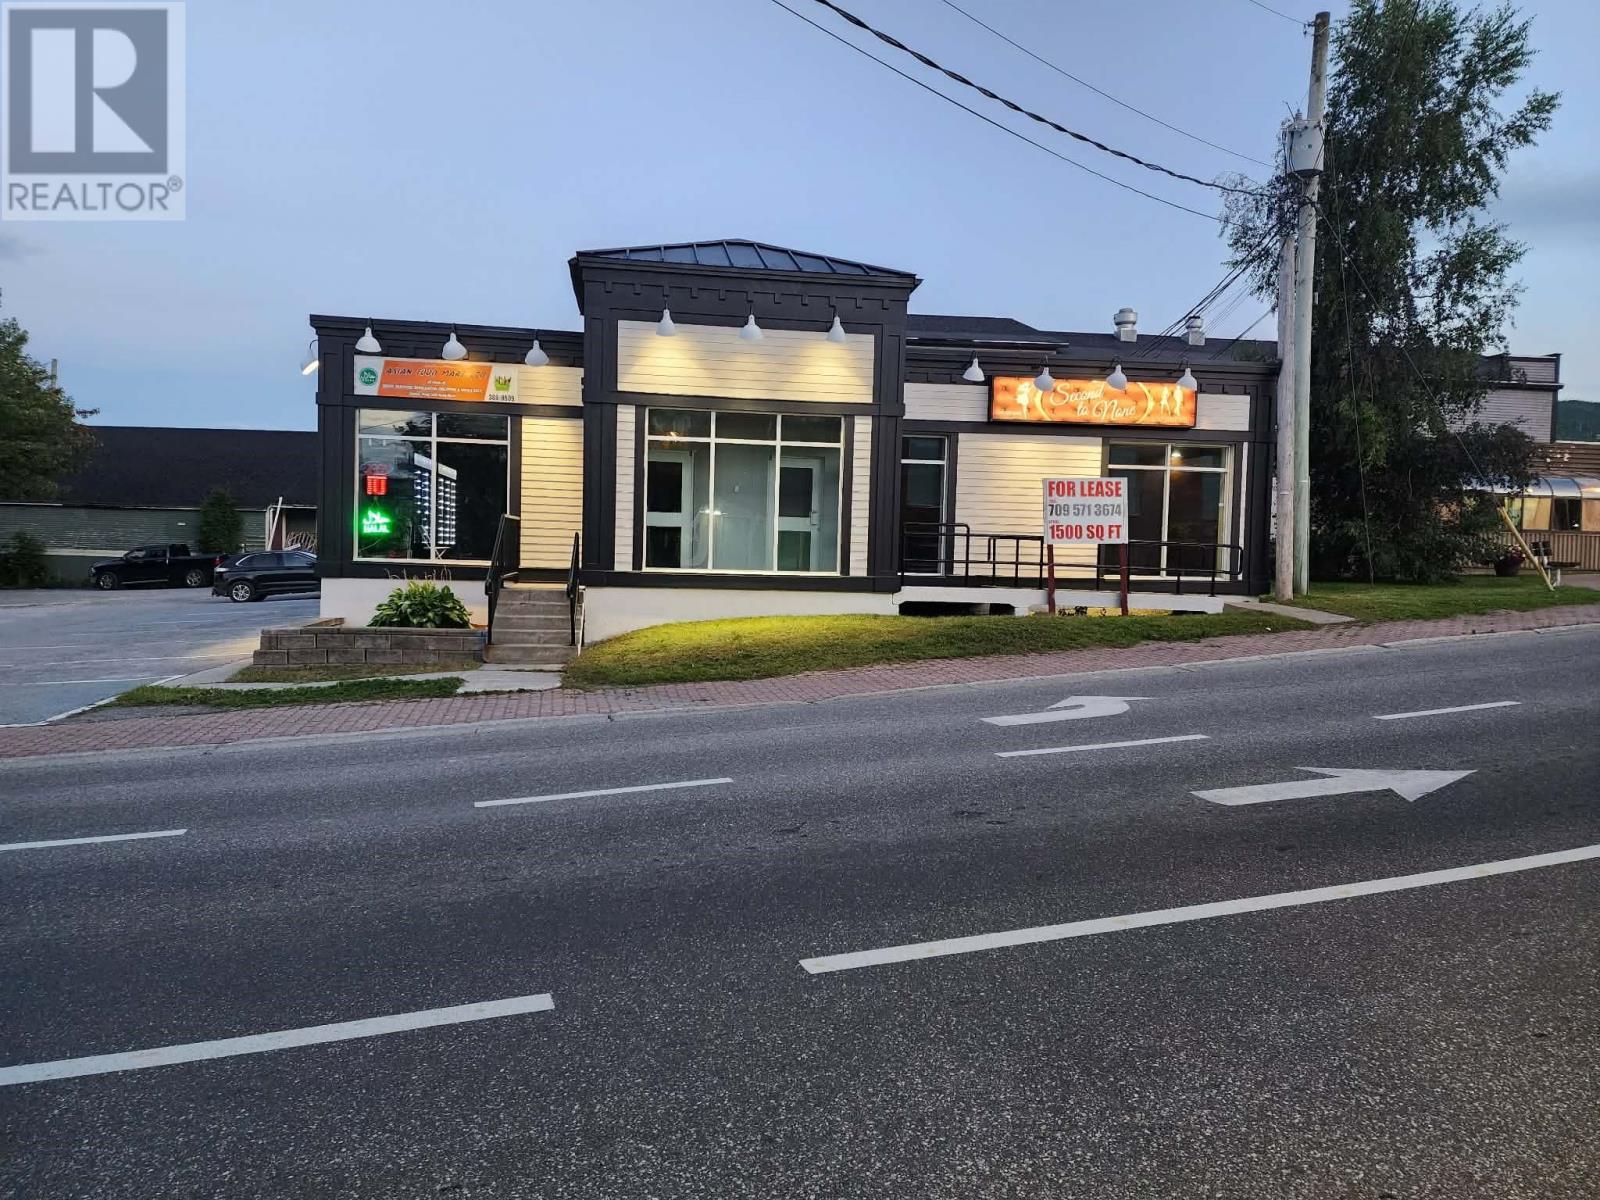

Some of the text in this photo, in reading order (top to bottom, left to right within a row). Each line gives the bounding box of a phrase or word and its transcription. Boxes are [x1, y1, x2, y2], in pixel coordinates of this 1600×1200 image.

[386, 367, 413, 376] ASIAN
[416, 368, 438, 377] FOOD
[1050, 382, 1105, 405] Second
[1077, 402, 1089, 417] to
[1093, 400, 1136, 419] None
[1048, 480, 1122, 497] FOR LEASE
[1048, 503, 1122, 516] 709 571 3674
[1049, 524, 1122, 541] 1500 SQ FT
